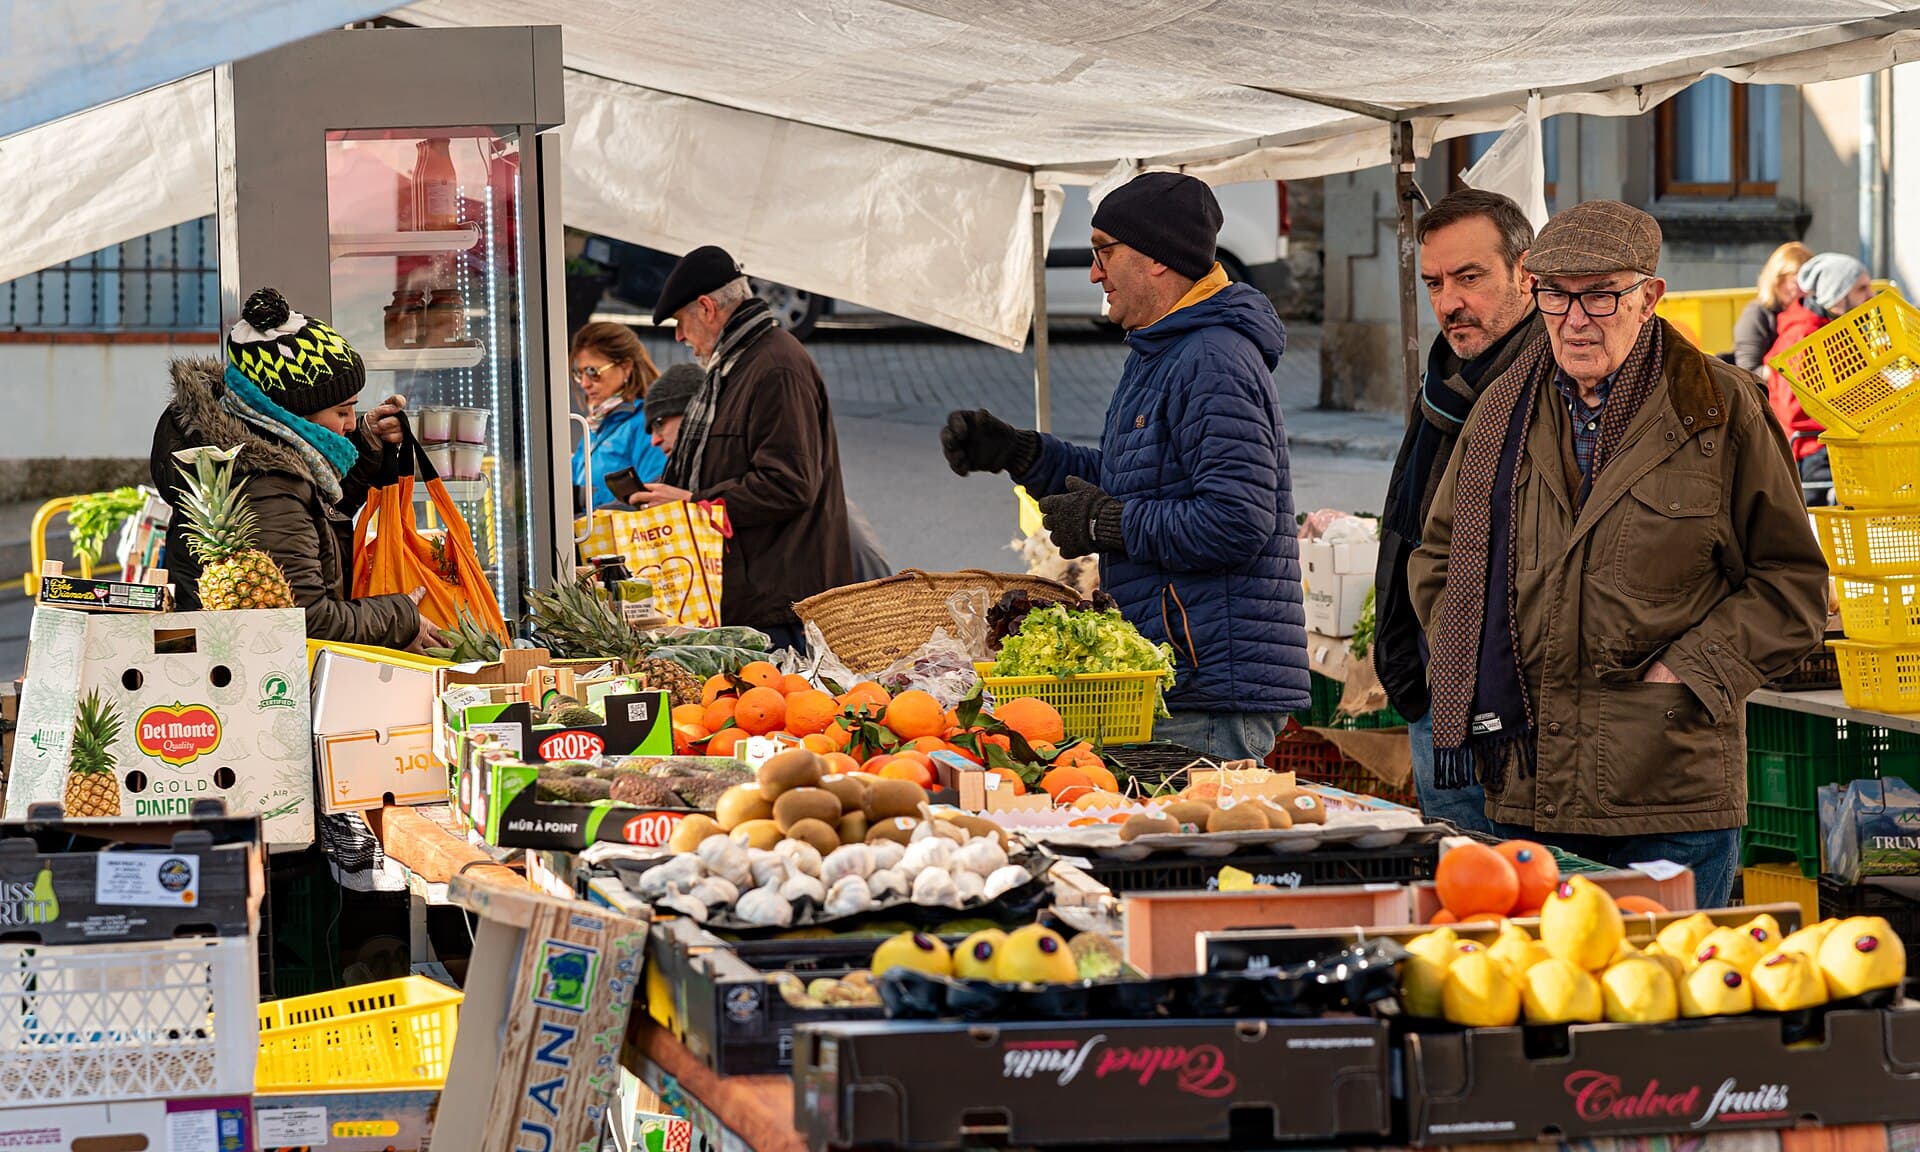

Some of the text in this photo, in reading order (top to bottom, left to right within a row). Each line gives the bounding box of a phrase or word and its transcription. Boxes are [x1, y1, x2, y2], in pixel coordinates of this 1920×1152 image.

[631, 525, 672, 543] ANETO
[143, 721, 215, 739] Del Monte
[163, 740, 194, 752] Quality
[543, 733, 602, 759] TROPS
[153, 779, 208, 793] GOLD
[259, 789, 289, 805] BY AIR
[508, 818, 534, 831] MÛR
[545, 821, 578, 833] POINT
[0, 880, 35, 902] ISS
[1003, 1034, 1237, 1098] Calvet fruits
[1564, 1069, 1790, 1129] Calvet fruits
